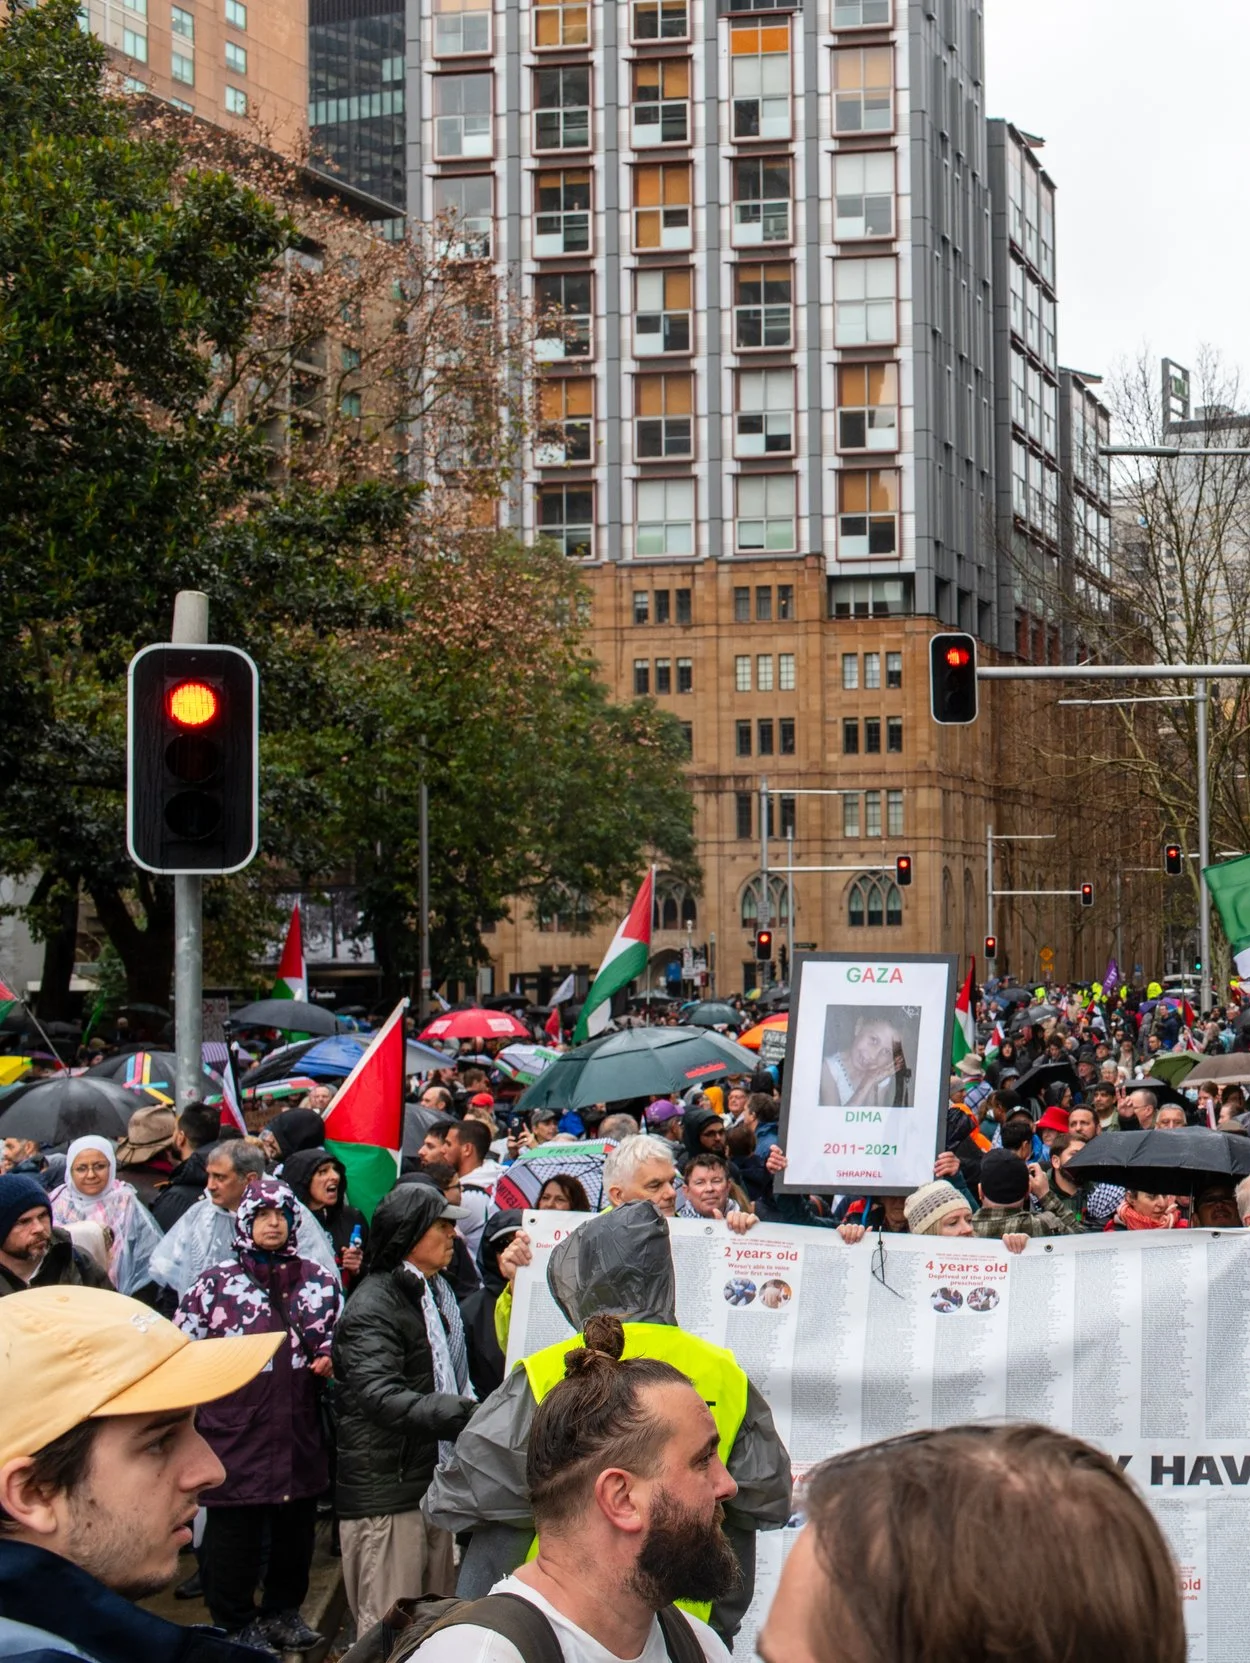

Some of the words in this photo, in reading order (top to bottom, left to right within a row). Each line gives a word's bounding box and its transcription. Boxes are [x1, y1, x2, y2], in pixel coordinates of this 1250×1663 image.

[846, 967, 903, 984] GAZA
[845, 1111, 882, 1123] DIMA
[823, 1143, 898, 1156] 2011-2021
[836, 1170, 882, 1178] SHRAPNEL
[724, 1246, 732, 1258] 2
[736, 1249, 772, 1261] years
[776, 1250, 798, 1261] old
[926, 1261, 934, 1270] 4
[940, 1263, 979, 1273] years
[984, 1263, 1008, 1272] old
[1182, 1578, 1200, 1590] old
